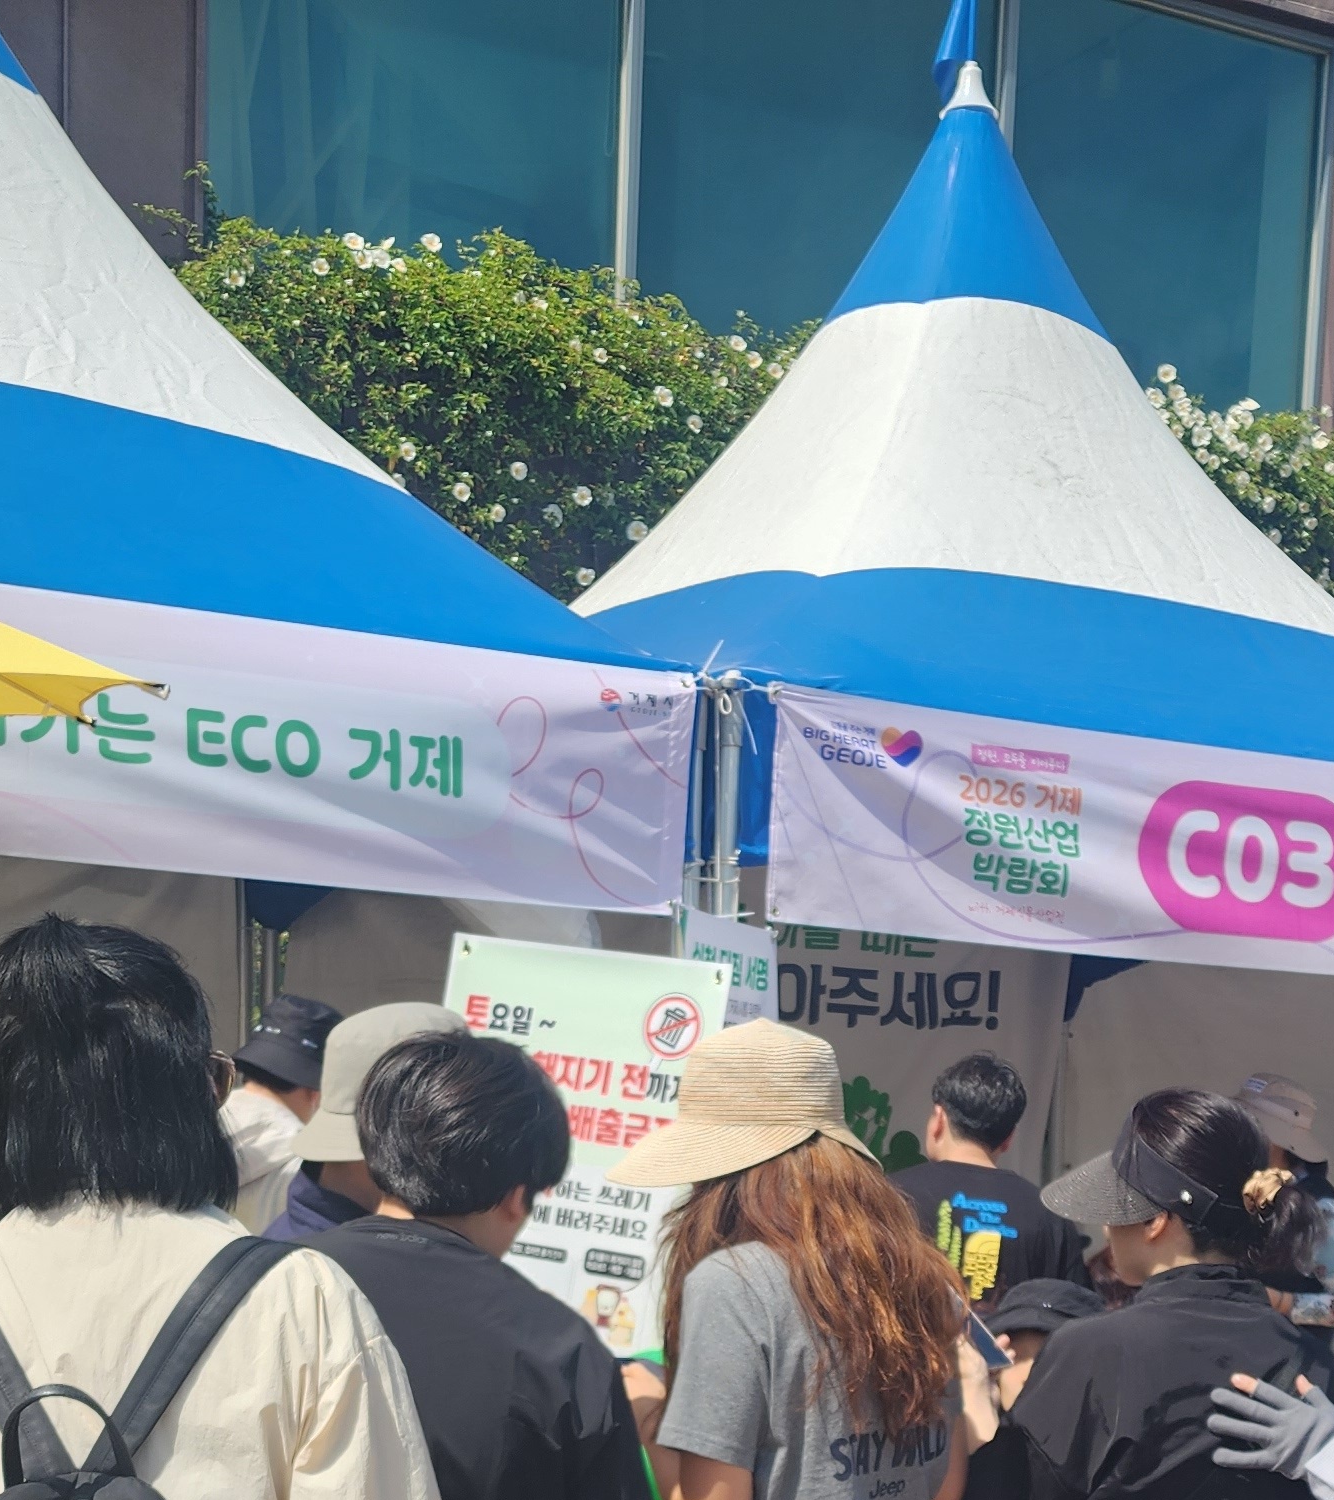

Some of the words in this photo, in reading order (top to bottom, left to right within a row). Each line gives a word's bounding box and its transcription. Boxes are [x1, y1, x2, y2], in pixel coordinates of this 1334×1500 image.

[185, 707, 321, 779] ECO
[348, 727, 463, 799] 거제
[803, 727, 830, 741] BIG
[820, 744, 888, 769] GEOJE
[959, 774, 1027, 808] 2026
[1035, 785, 1083, 816] 거제
[964, 807, 1082, 858] 정원산업
[973, 852, 1069, 898] 박람회
[464, 994, 535, 1036] 토요일
[566, 1105, 675, 1149] 배출금
[595, 1185, 653, 1213] 쓰레기
[554, 1206, 649, 1241] 버려주세요
[830, 1430, 889, 1482] STAY
[868, 1479, 906, 1500] Jeep
